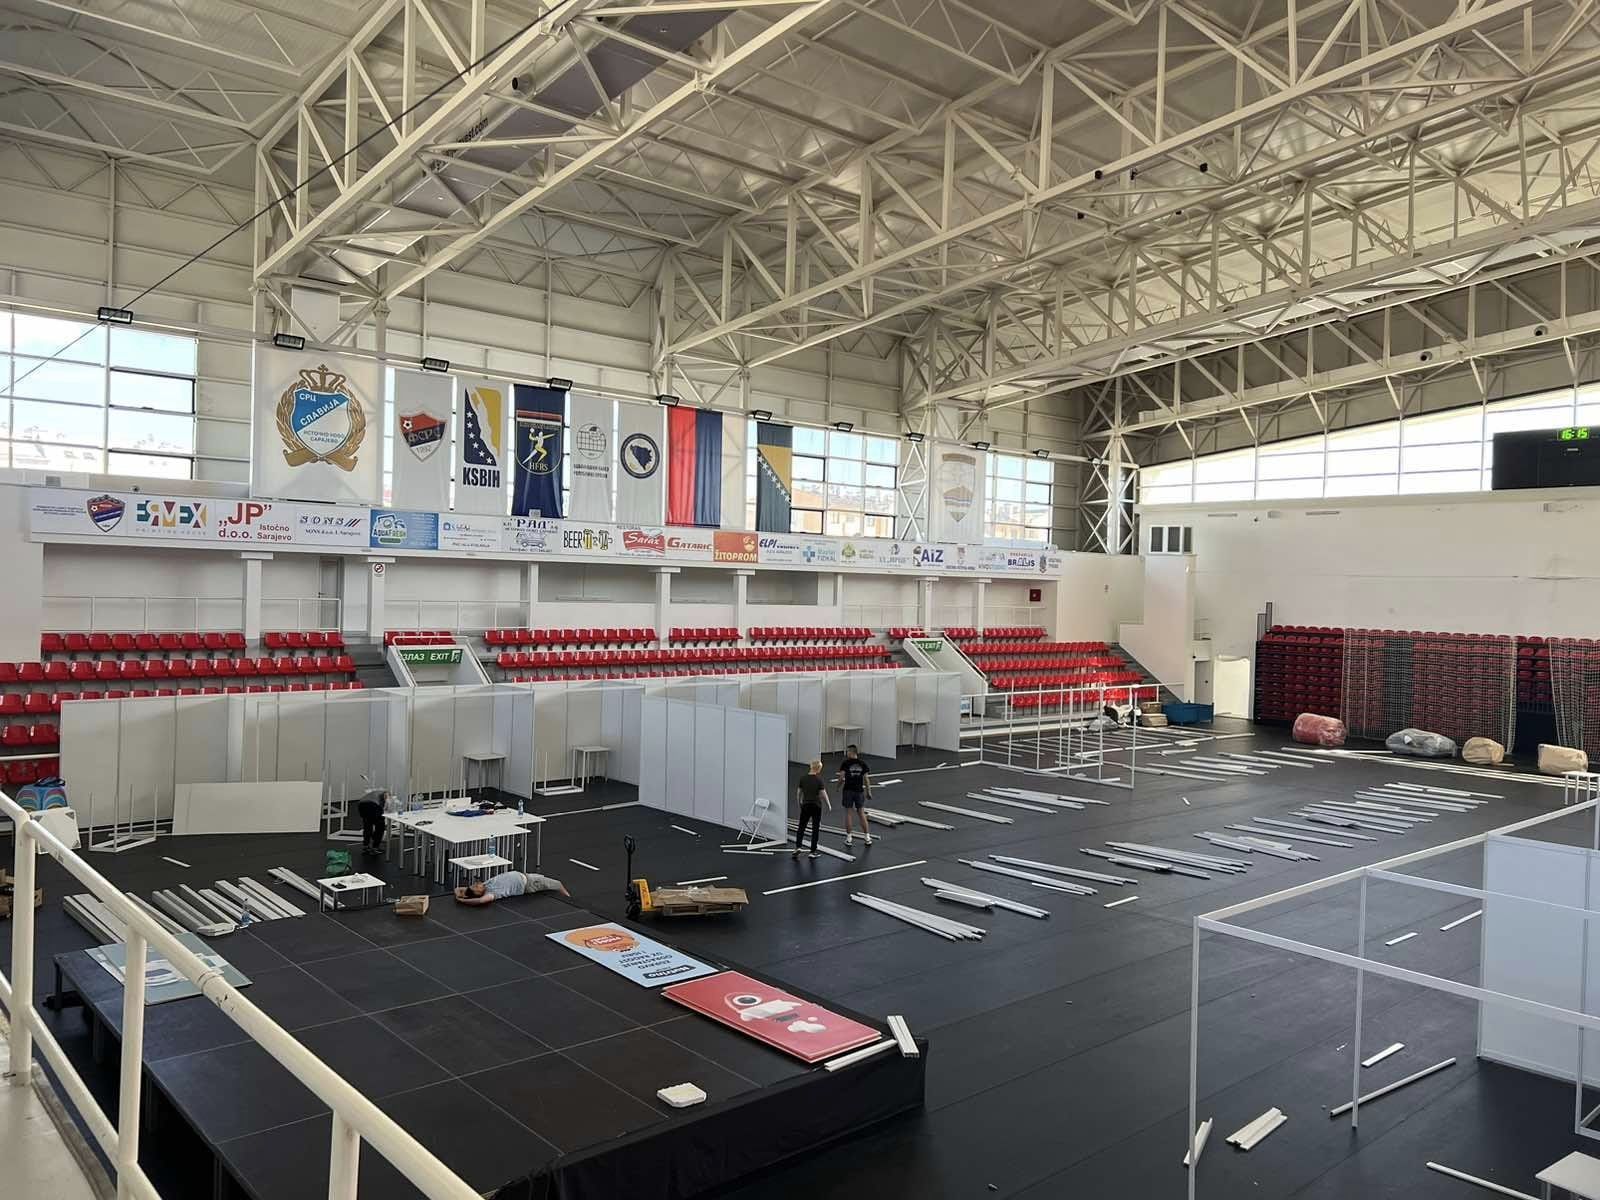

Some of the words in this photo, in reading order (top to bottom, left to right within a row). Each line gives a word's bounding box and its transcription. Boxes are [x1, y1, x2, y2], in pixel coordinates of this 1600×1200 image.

[299, 393, 317, 401] СРЦ
[300, 398, 340, 426] СЛАВИЈА
[1561, 427, 1588, 440] 16:15
[463, 467, 500, 488] KSBIH
[259, 523, 290, 532] Istočno
[218, 528, 253, 539] d.o.o.
[257, 532, 292, 542] Sarajevo
[563, 530, 582, 548] BEER
[759, 538, 777, 548] ELPI
[715, 550, 757, 561] ŽITOPROM
[430, 652, 450, 661] EXIT
